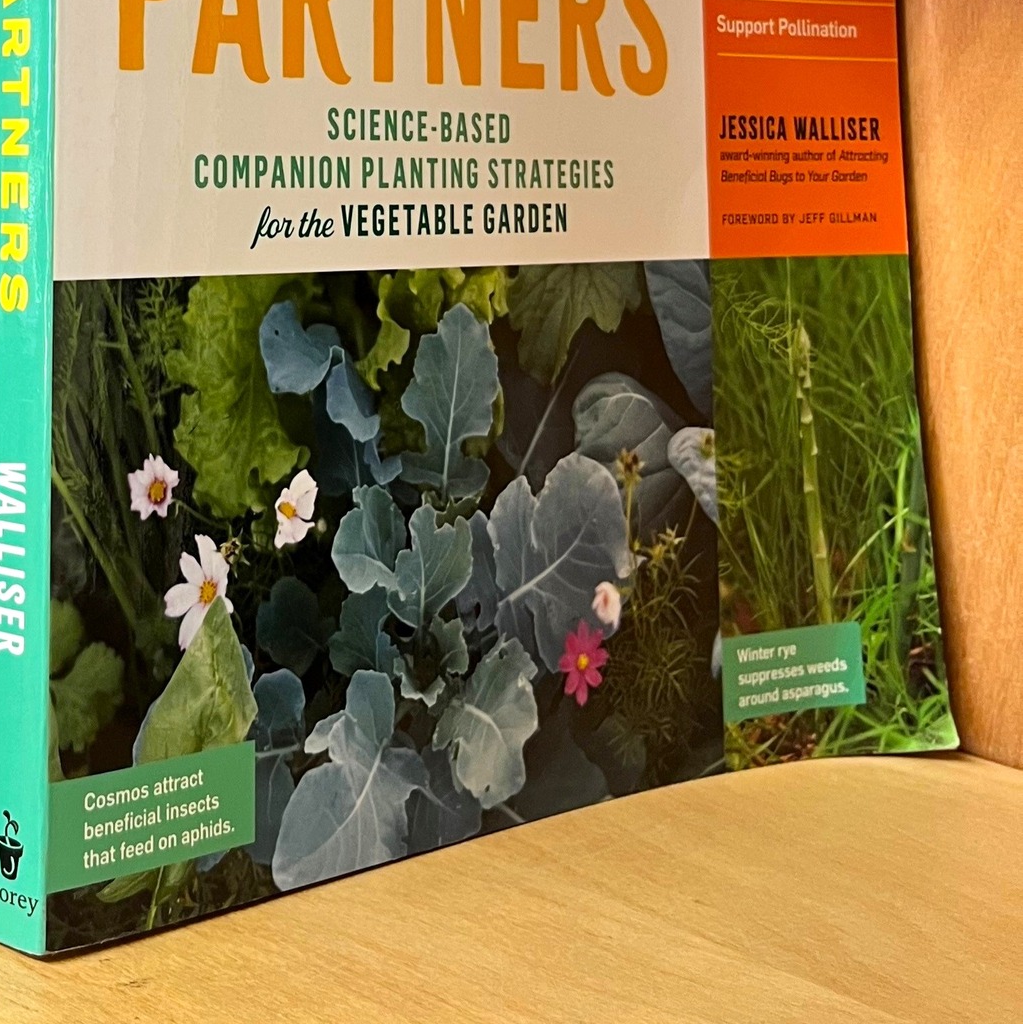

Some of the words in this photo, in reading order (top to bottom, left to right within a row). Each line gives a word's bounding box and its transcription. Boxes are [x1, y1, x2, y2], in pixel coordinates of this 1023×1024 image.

[716, 14, 775, 37] Support
[778, 18, 857, 39] Pollination
[327, 108, 511, 144] SCIENCE-BASED
[719, 115, 787, 141] JESSICA
[793, 116, 881, 141] WALLISER
[720, 149, 789, 164] award-winning
[792, 149, 823, 161] author
[827, 149, 836, 161] of
[839, 150, 889, 163] Attracting
[193, 154, 351, 190] COMPANION
[360, 157, 479, 190] PLANTING
[487, 159, 615, 189] STRATEGIES
[721, 169, 767, 183] Beneficial
[769, 170, 793, 185] Bugs
[795, 171, 806, 182] to
[808, 170, 828, 182] Your
[831, 170, 868, 182] Garden
[250, 206, 296, 250] for
[298, 209, 335, 239] the
[341, 203, 474, 238] VEGETABLE
[483, 203, 568, 235] GARDEN
[722, 213, 779, 225] FOREWORD
[782, 213, 796, 224] BY
[798, 212, 825, 224] JEFF
[829, 212, 877, 224] GILLMAN
[737, 647, 774, 663] Winter
[778, 644, 797, 660] rye
[738, 664, 805, 687] suppresses
[807, 657, 848, 674] weeds
[738, 687, 779, 708] around
[782, 681, 849, 701] asparagus.
[84, 784, 149, 811] Cosmos
[153, 769, 204, 796] attract
[84, 805, 162, 840] beneficial
[166, 794, 220, 821] insects
[83, 845, 116, 869] that
[120, 836, 154, 860] feed
[158, 834, 177, 851] on
[181, 818, 235, 846] aphids.
